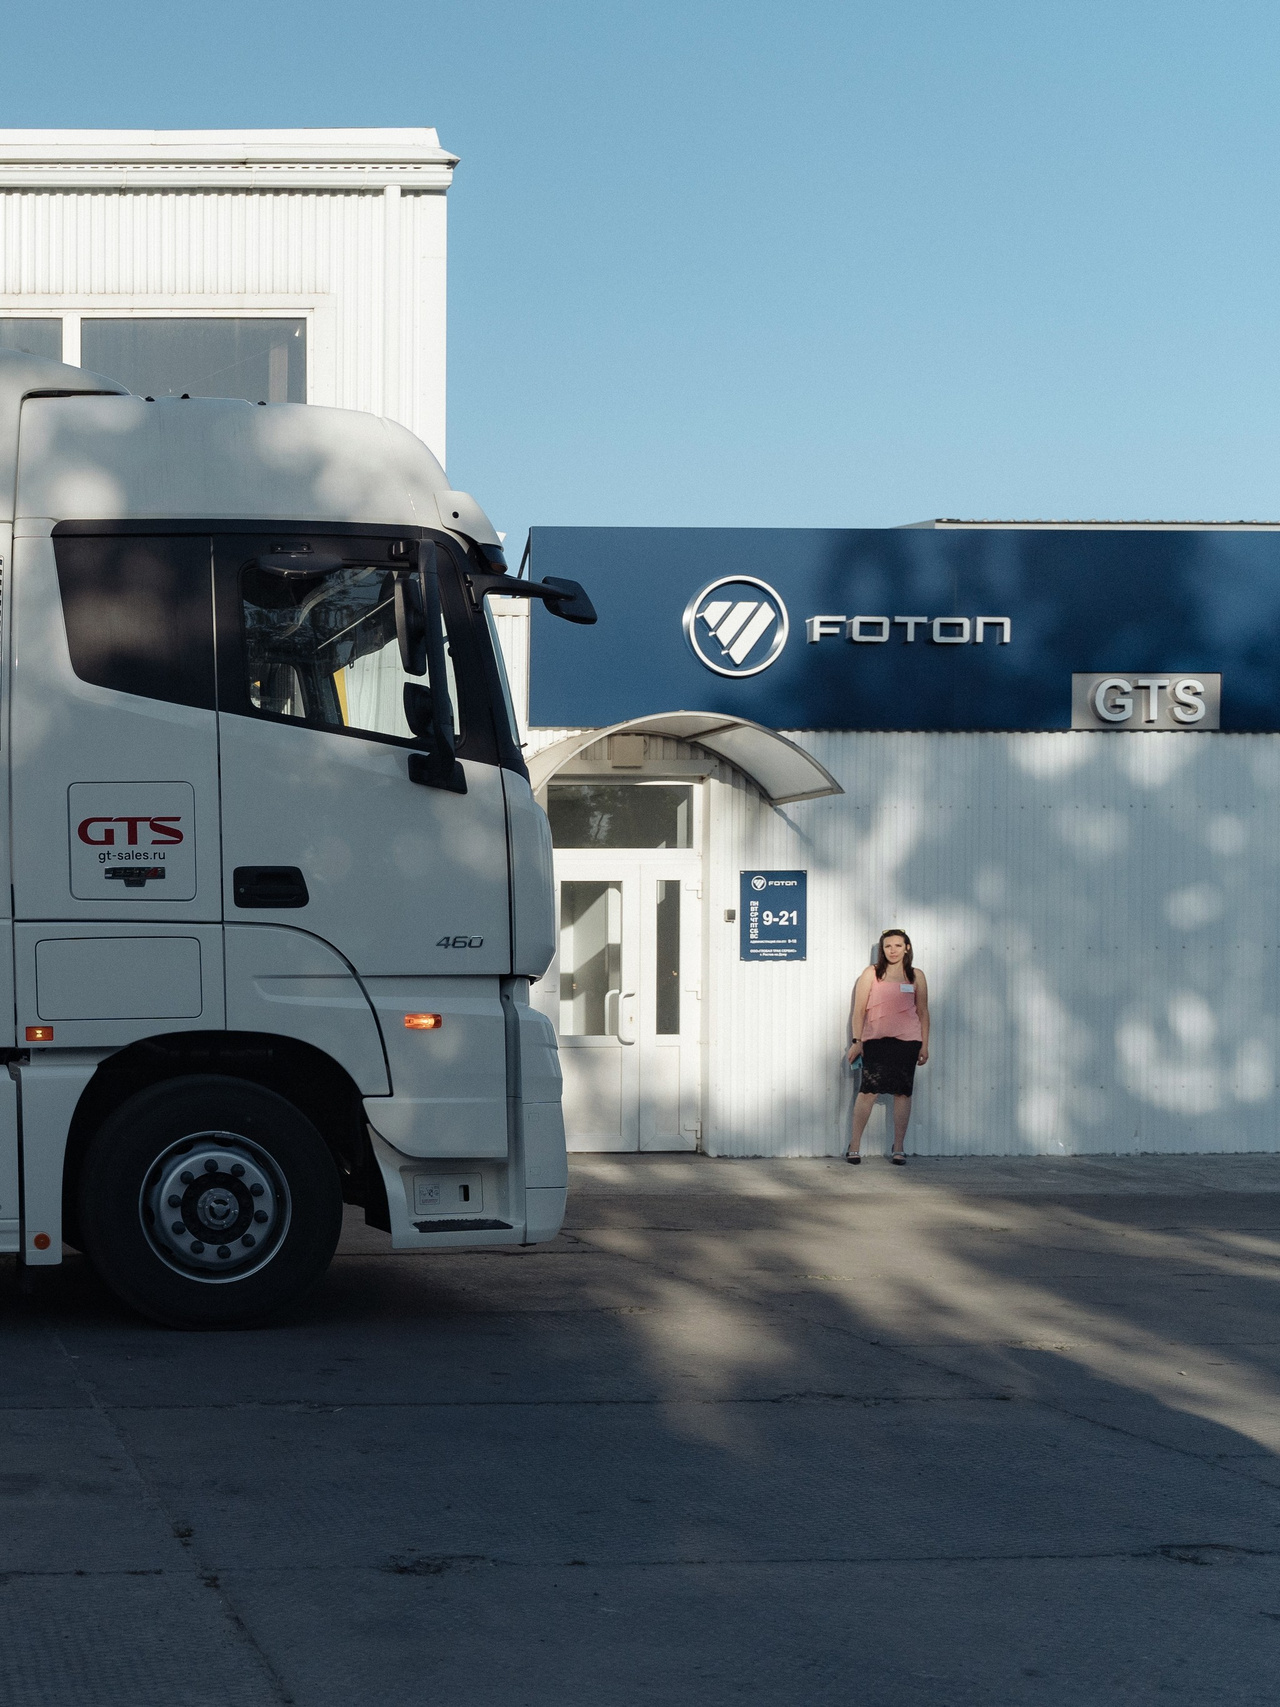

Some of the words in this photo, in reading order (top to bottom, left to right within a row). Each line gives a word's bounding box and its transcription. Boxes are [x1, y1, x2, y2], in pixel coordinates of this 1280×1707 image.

[805, 615, 1011, 644] FOTON
[1091, 677, 1206, 724] GTS
[77, 816, 184, 846] GTS
[98, 850, 166, 864] gt-sales.ru
[762, 910, 798, 926] 9-21
[435, 935, 484, 949] 460
